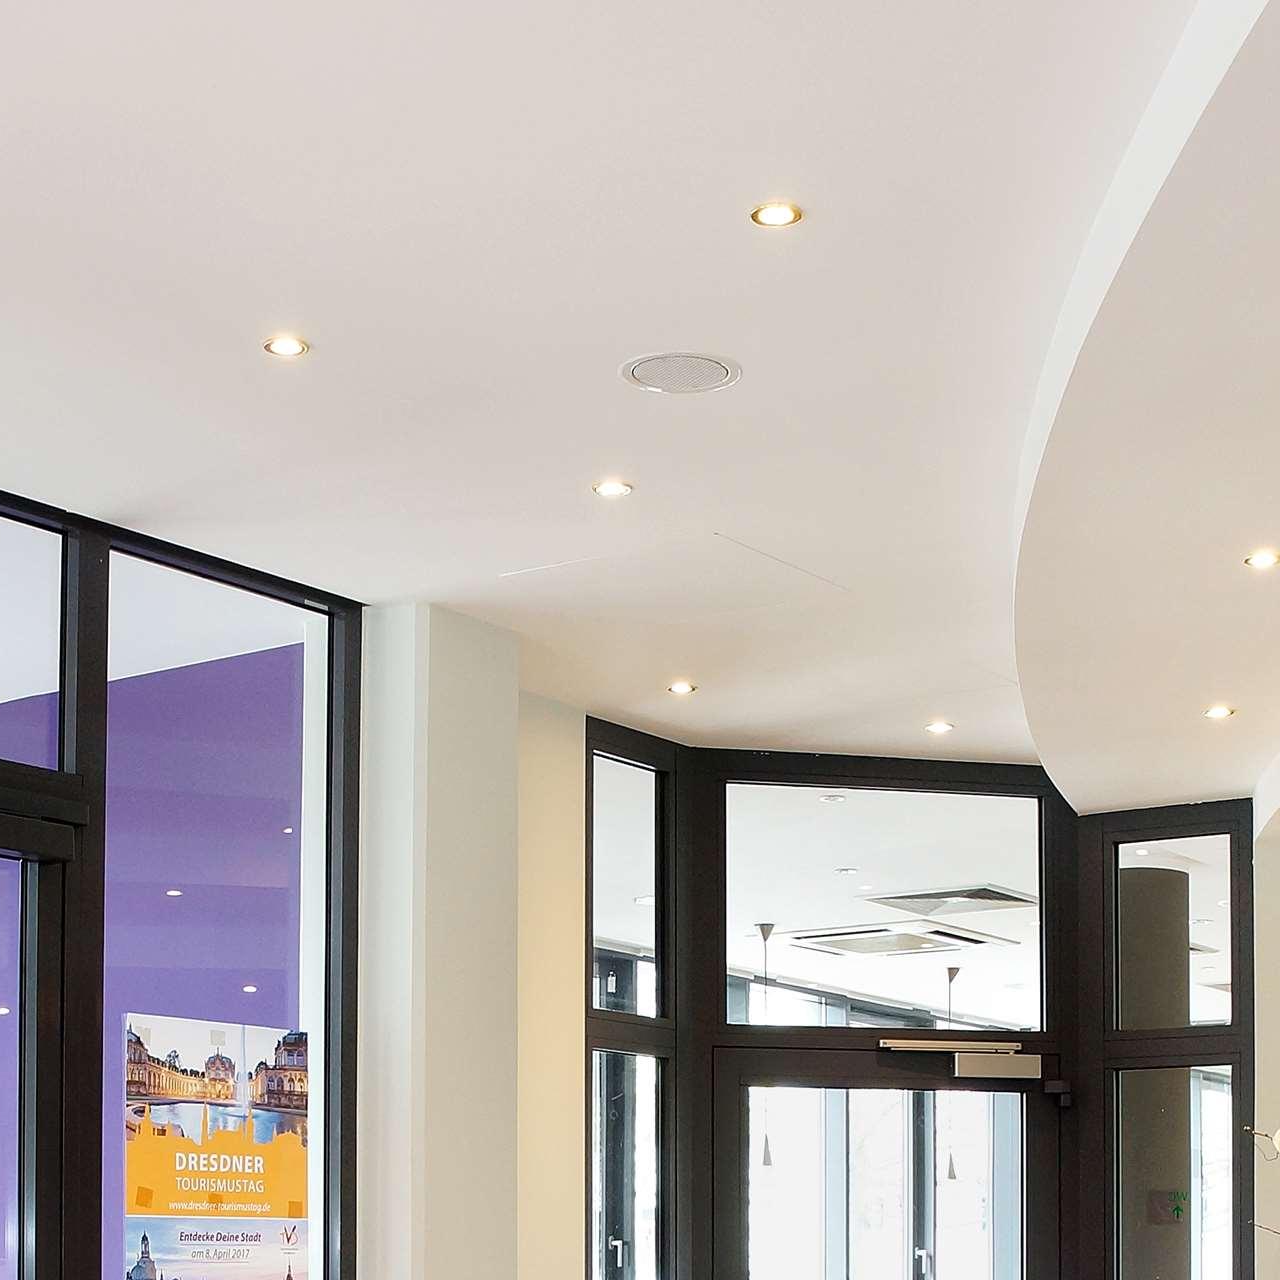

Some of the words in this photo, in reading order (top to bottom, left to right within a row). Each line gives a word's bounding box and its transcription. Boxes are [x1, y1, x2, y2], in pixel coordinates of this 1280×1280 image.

[174, 1151, 265, 1174] DRESDNER
[175, 1176, 265, 1194] TOURISMUSTAG
[179, 1231, 215, 1243] Entdecke
[215, 1231, 240, 1242] Deine
[240, 1232, 262, 1243] Stadt
[191, 1250, 205, 1259] am
[212, 1248, 231, 1260] April
[231, 1248, 250, 1259] 2017
